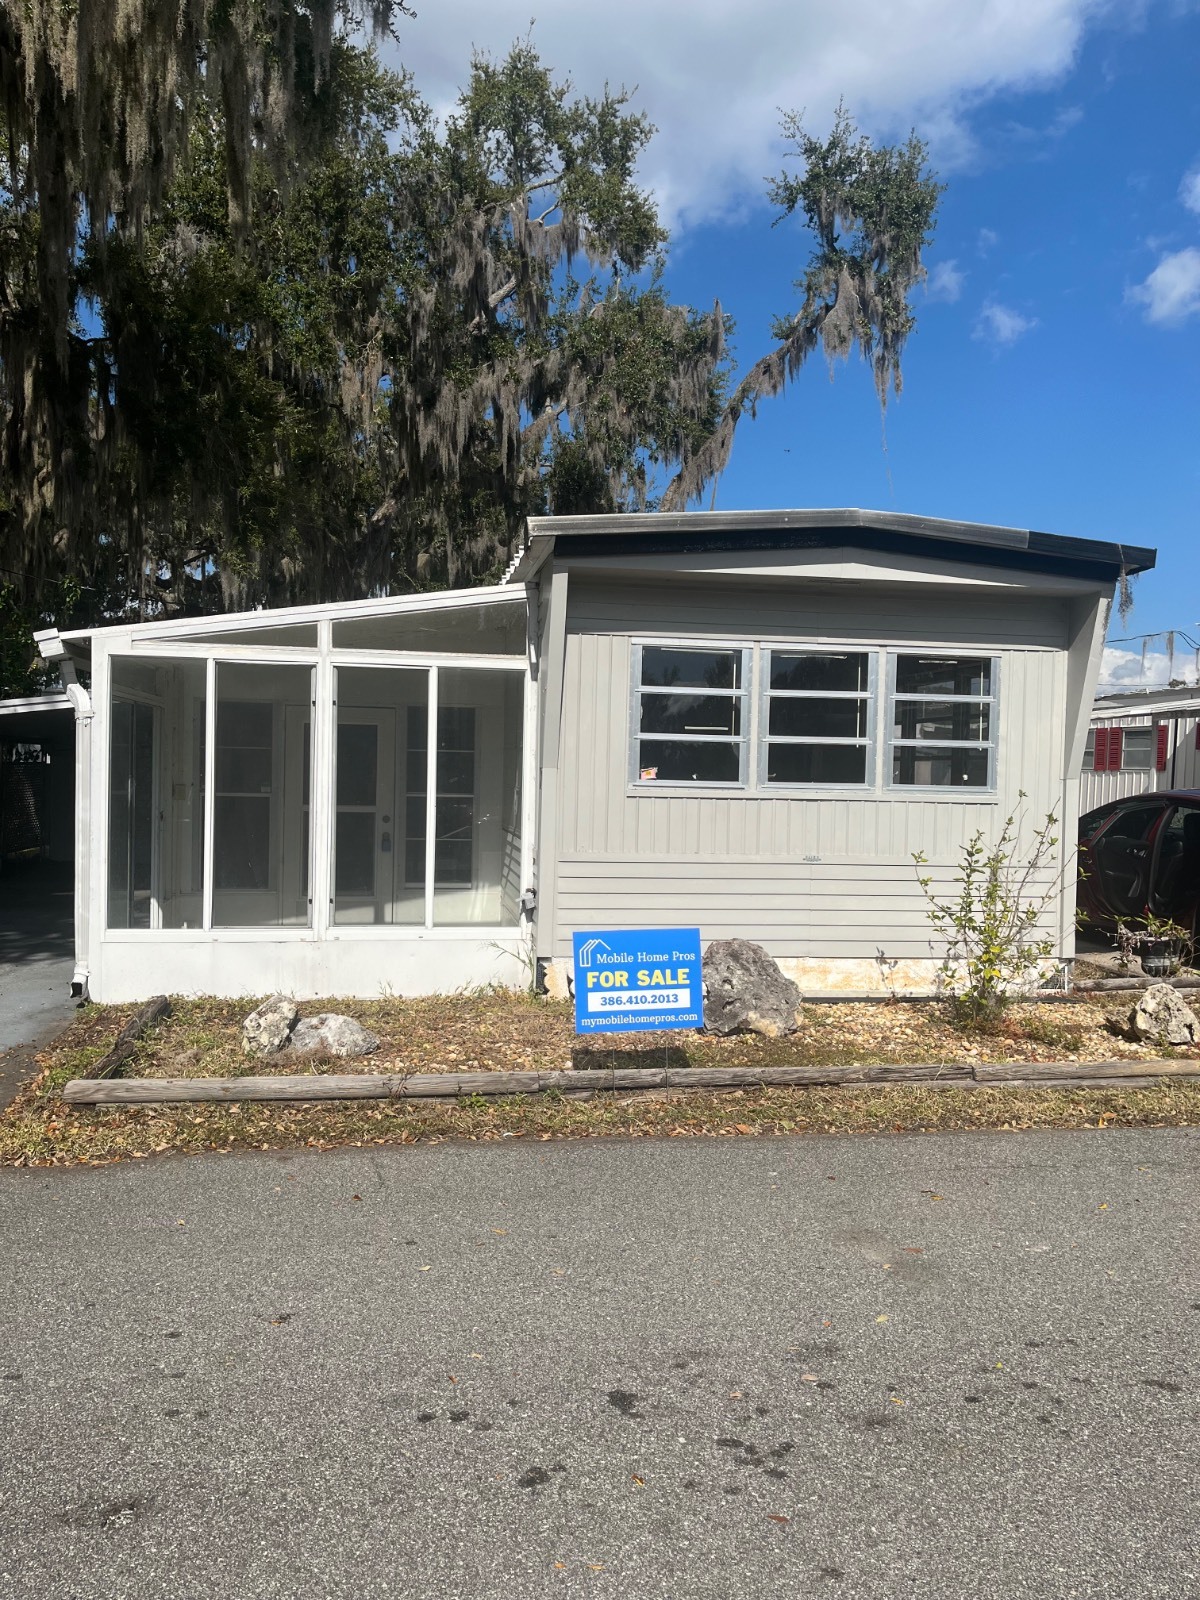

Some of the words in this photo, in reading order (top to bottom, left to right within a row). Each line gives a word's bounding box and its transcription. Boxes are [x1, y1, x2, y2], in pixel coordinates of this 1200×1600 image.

[596, 952, 634, 964] Mobile
[637, 952, 669, 962] Home
[672, 951, 696, 961] Pros
[586, 970, 629, 988] FOR
[637, 968, 690, 986] SALE
[600, 993, 679, 1006] 386.410.2013
[581, 1013, 698, 1028] mymobilehomepros.com
